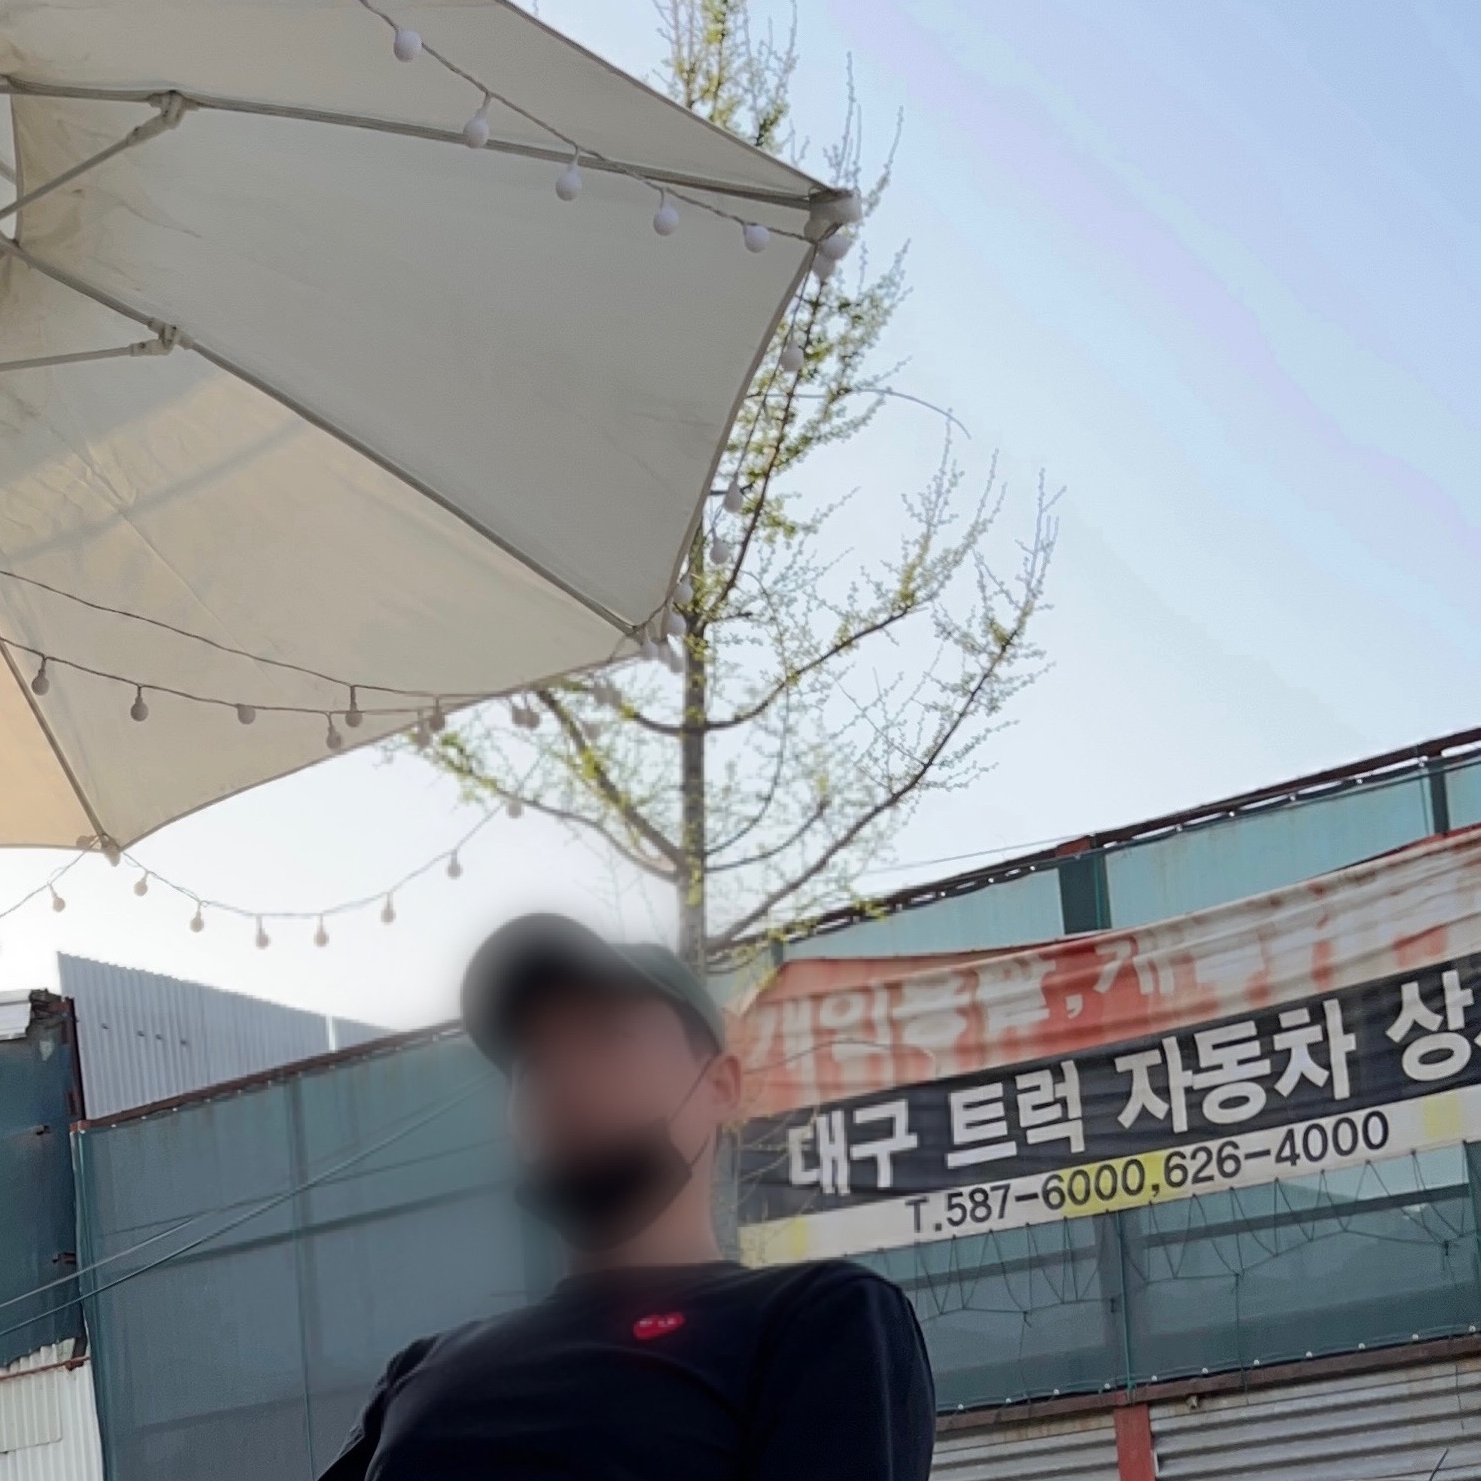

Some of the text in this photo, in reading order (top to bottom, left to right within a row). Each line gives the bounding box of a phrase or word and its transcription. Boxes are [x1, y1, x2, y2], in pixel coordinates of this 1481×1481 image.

[789, 970, 1481, 1196] 대구 트럭 자동차 상
